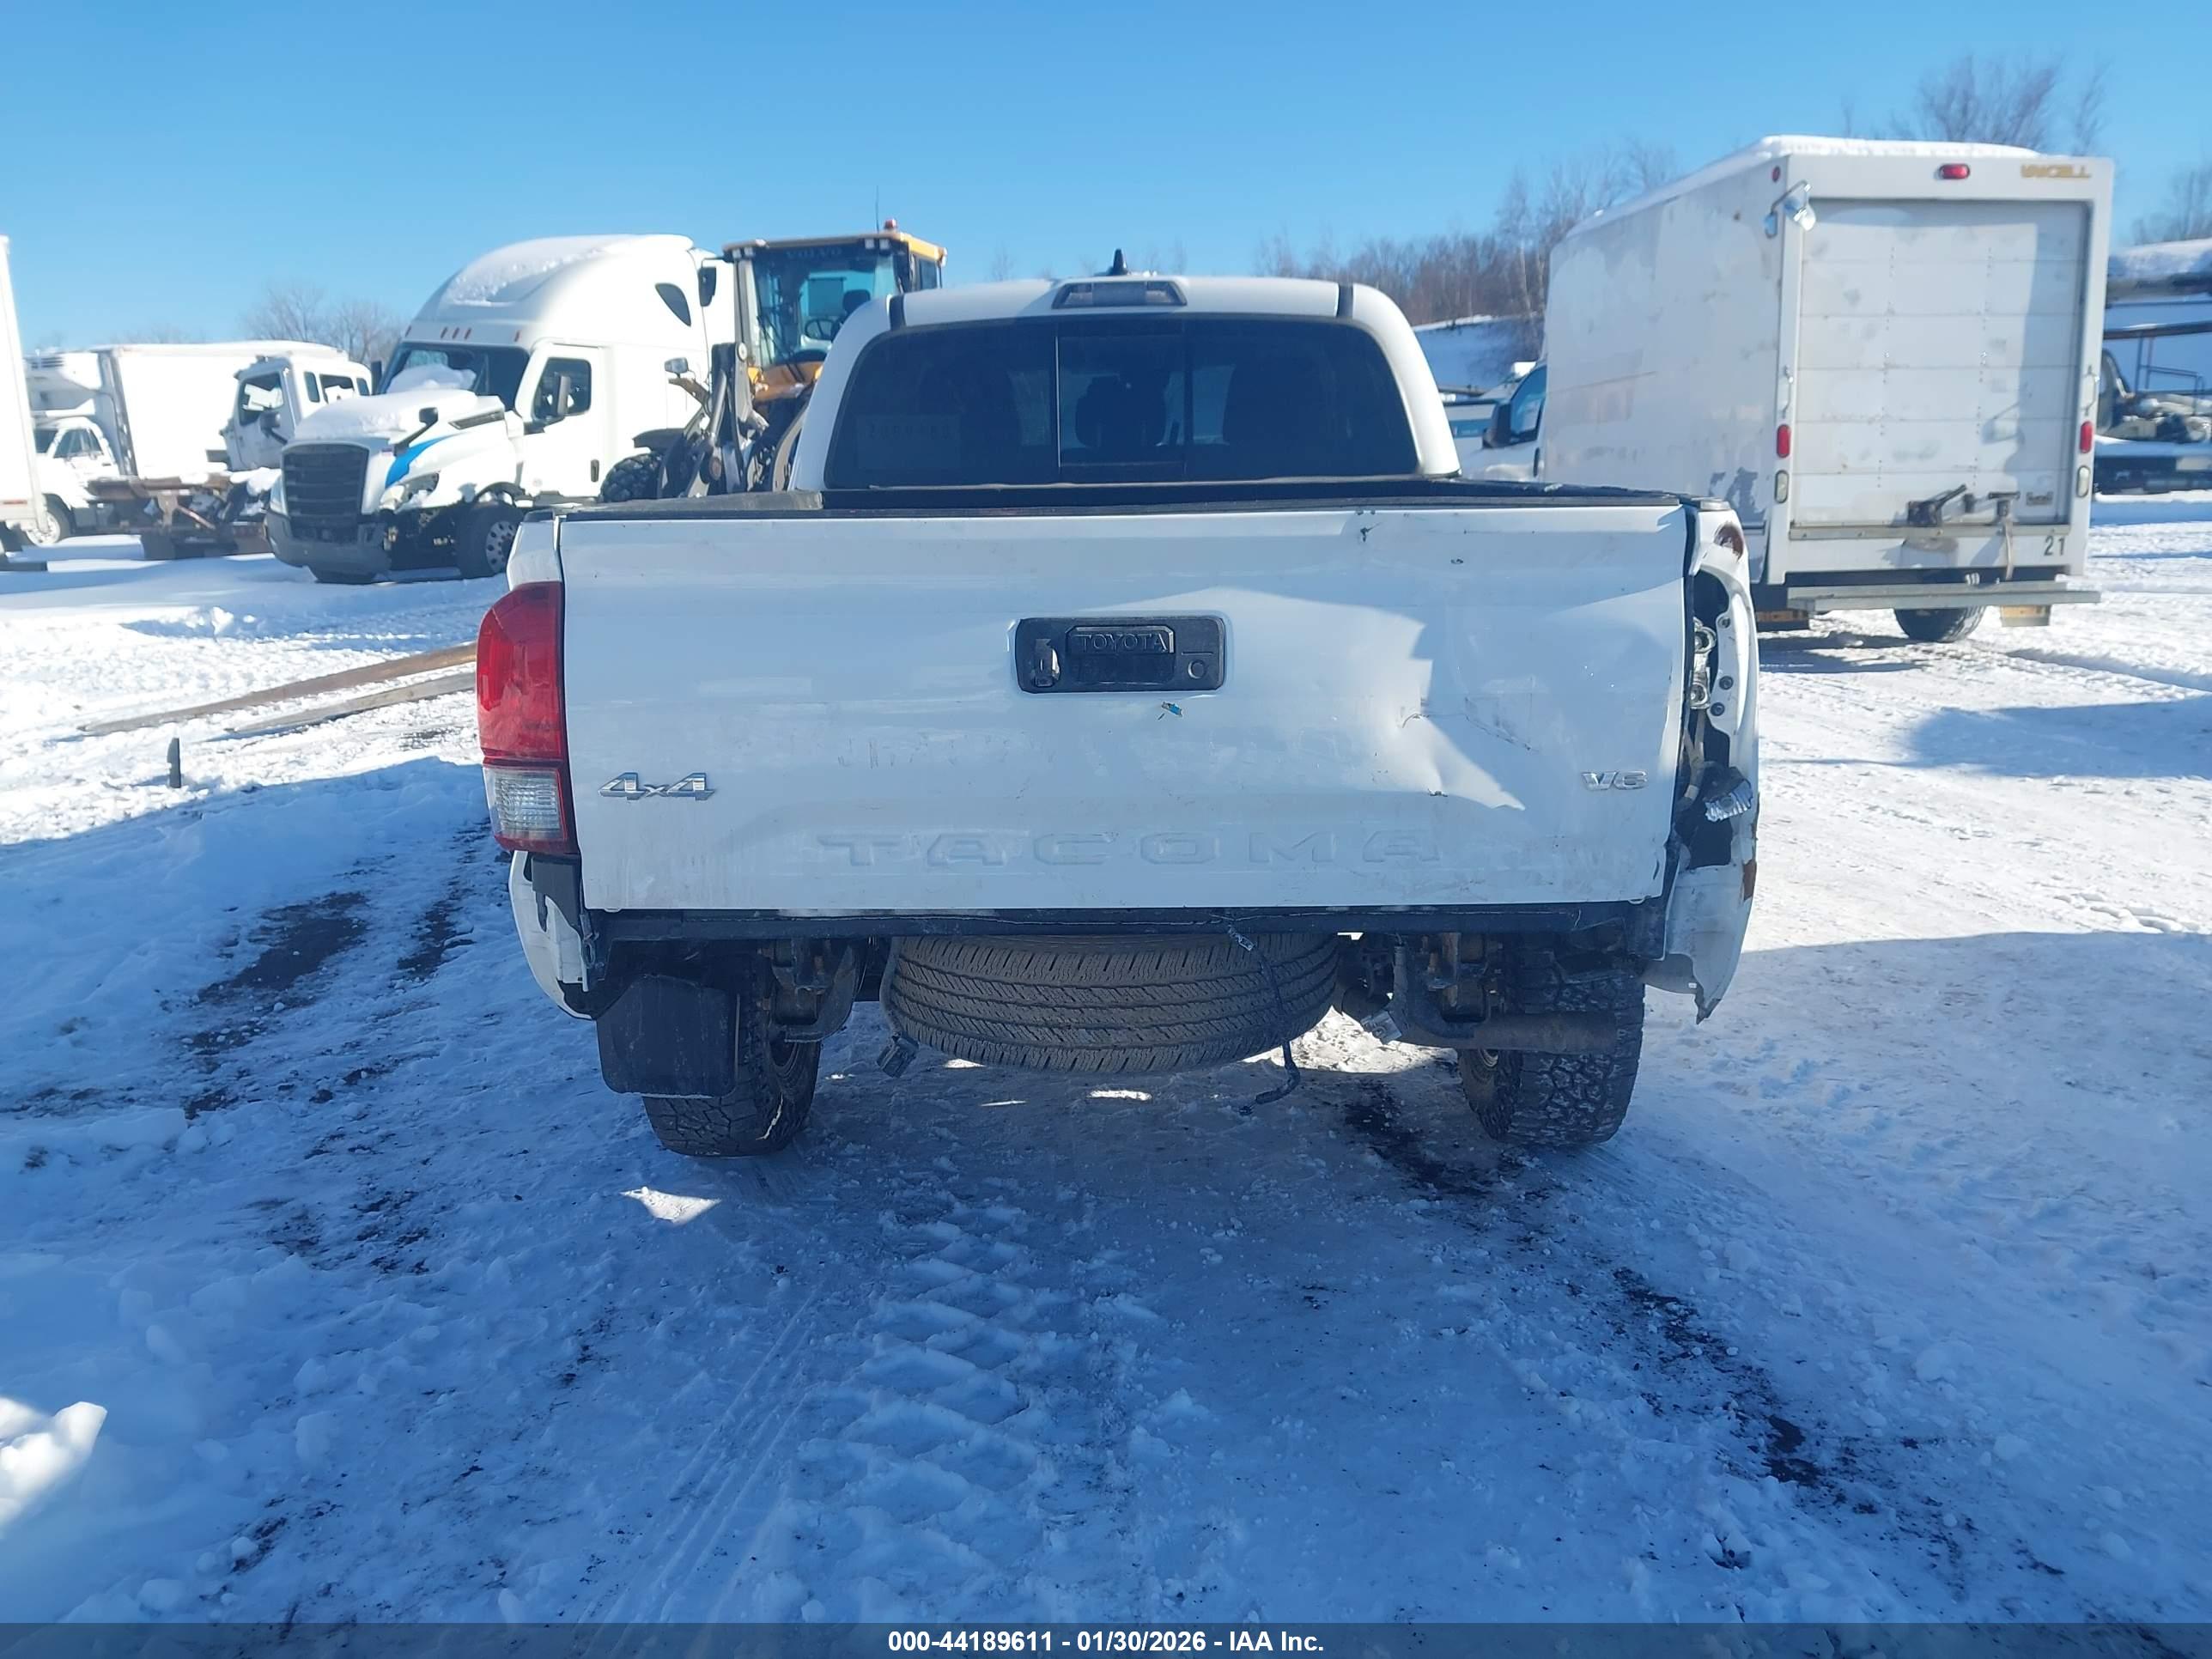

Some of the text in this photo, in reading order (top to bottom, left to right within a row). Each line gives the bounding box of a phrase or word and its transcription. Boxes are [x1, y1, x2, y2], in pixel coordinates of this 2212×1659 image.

[2043, 535, 2066, 556] 21
[1075, 633, 1169, 653] TOYOTA
[599, 771, 715, 800] 4x4
[1580, 770, 1648, 791] V6
[817, 831, 1442, 866] TACOMA
